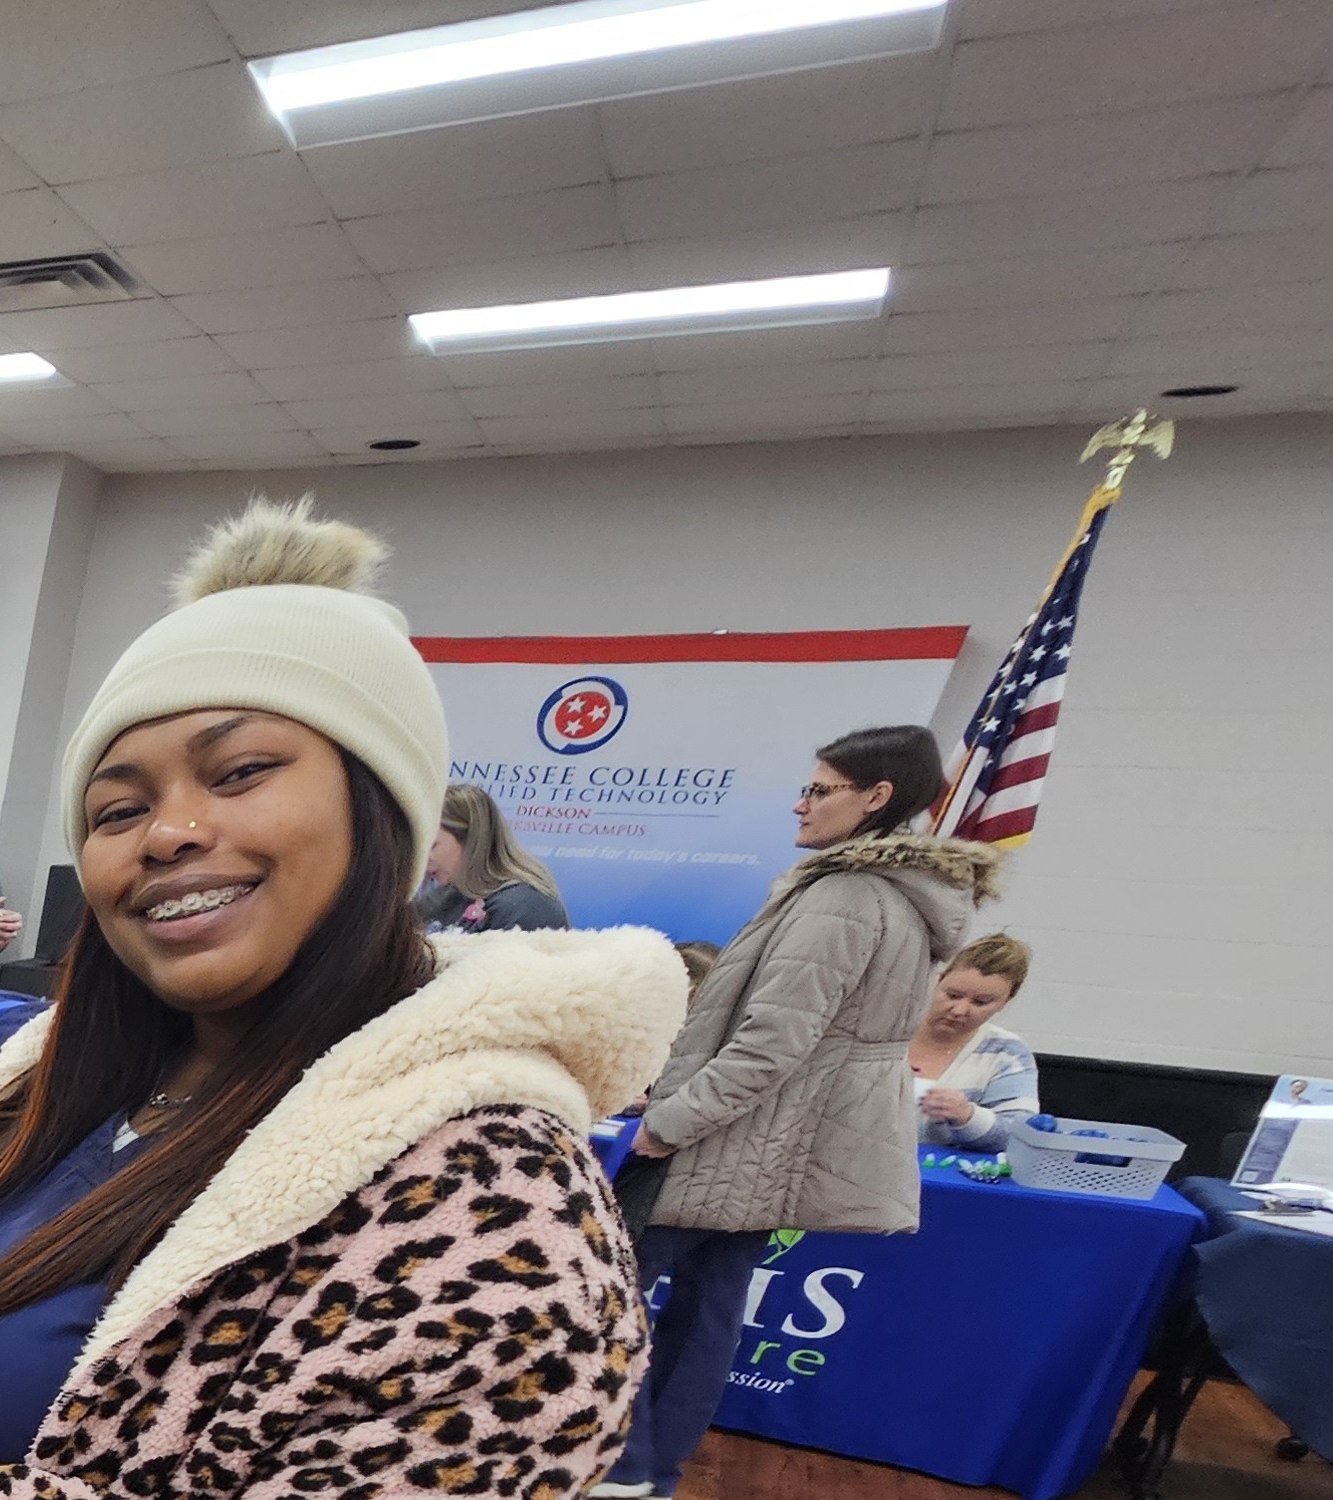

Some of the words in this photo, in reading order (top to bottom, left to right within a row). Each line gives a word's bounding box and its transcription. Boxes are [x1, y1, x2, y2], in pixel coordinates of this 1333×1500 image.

[448, 761, 577, 786] NNESSEE
[589, 766, 737, 789] COLLEGE
[549, 787, 730, 806] TECHNOLOGY
[516, 805, 592, 819] DICKSON
[578, 823, 647, 837] CAMPUS
[555, 845, 595, 859] need
[599, 847, 623, 860] for
[627, 848, 687, 864] today's
[691, 851, 760, 866] careers.
